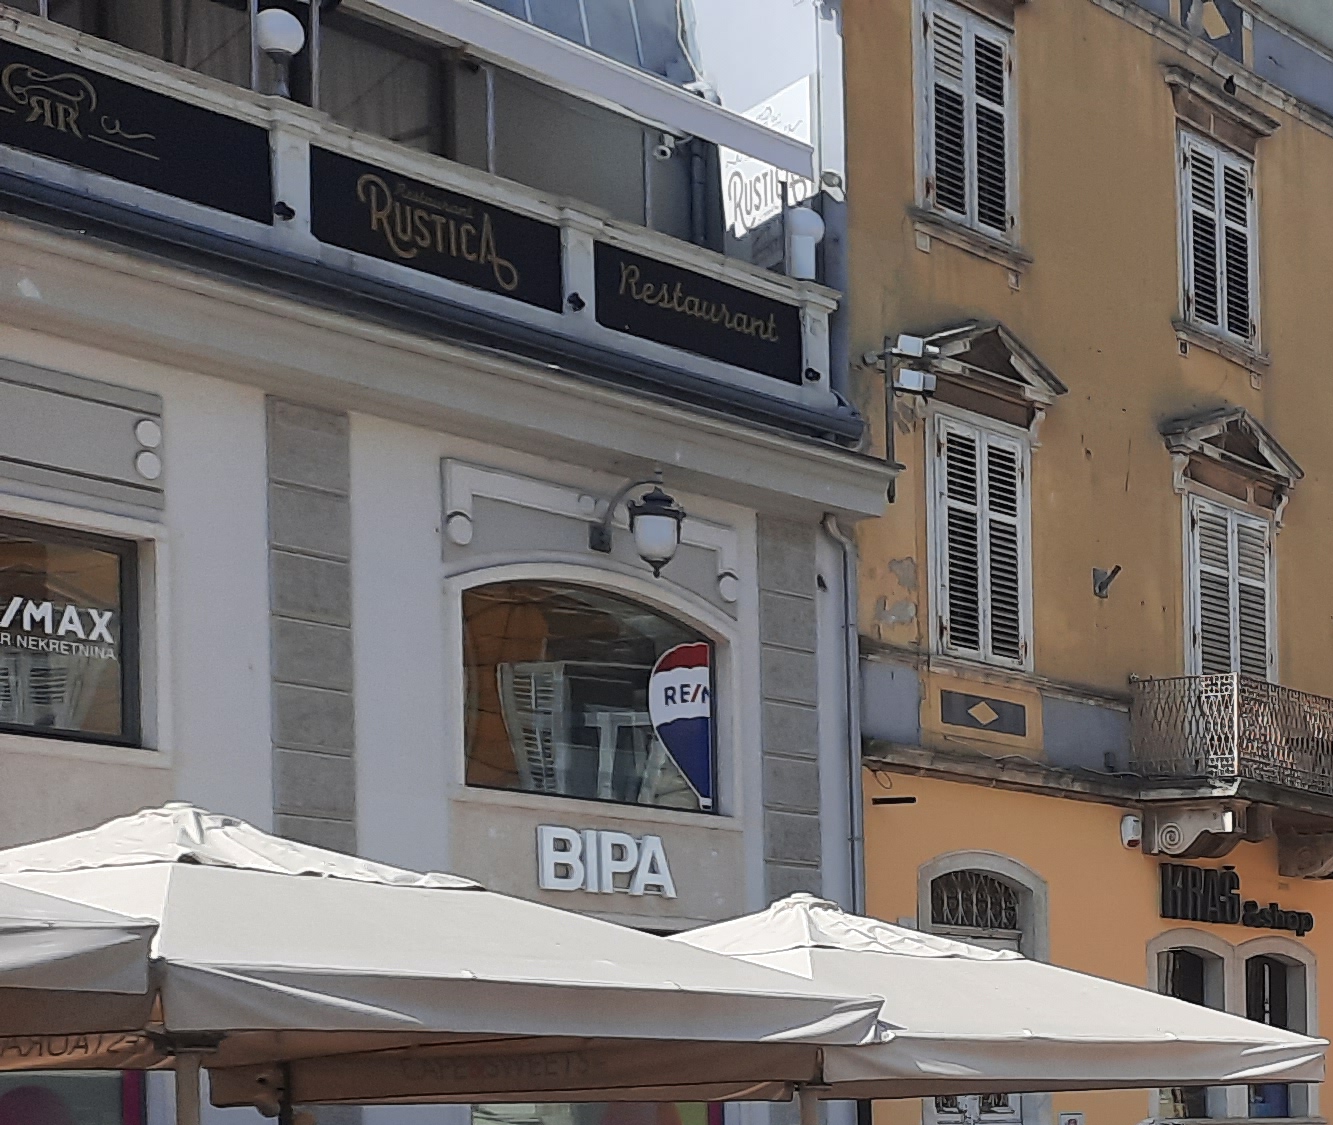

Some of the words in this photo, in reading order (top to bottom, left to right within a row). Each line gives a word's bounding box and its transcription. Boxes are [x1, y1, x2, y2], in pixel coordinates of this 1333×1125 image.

[619, 261, 779, 342] Restaurant
[17, 635, 118, 661] NEKRETNINA
[537, 825, 677, 898] BIPA
